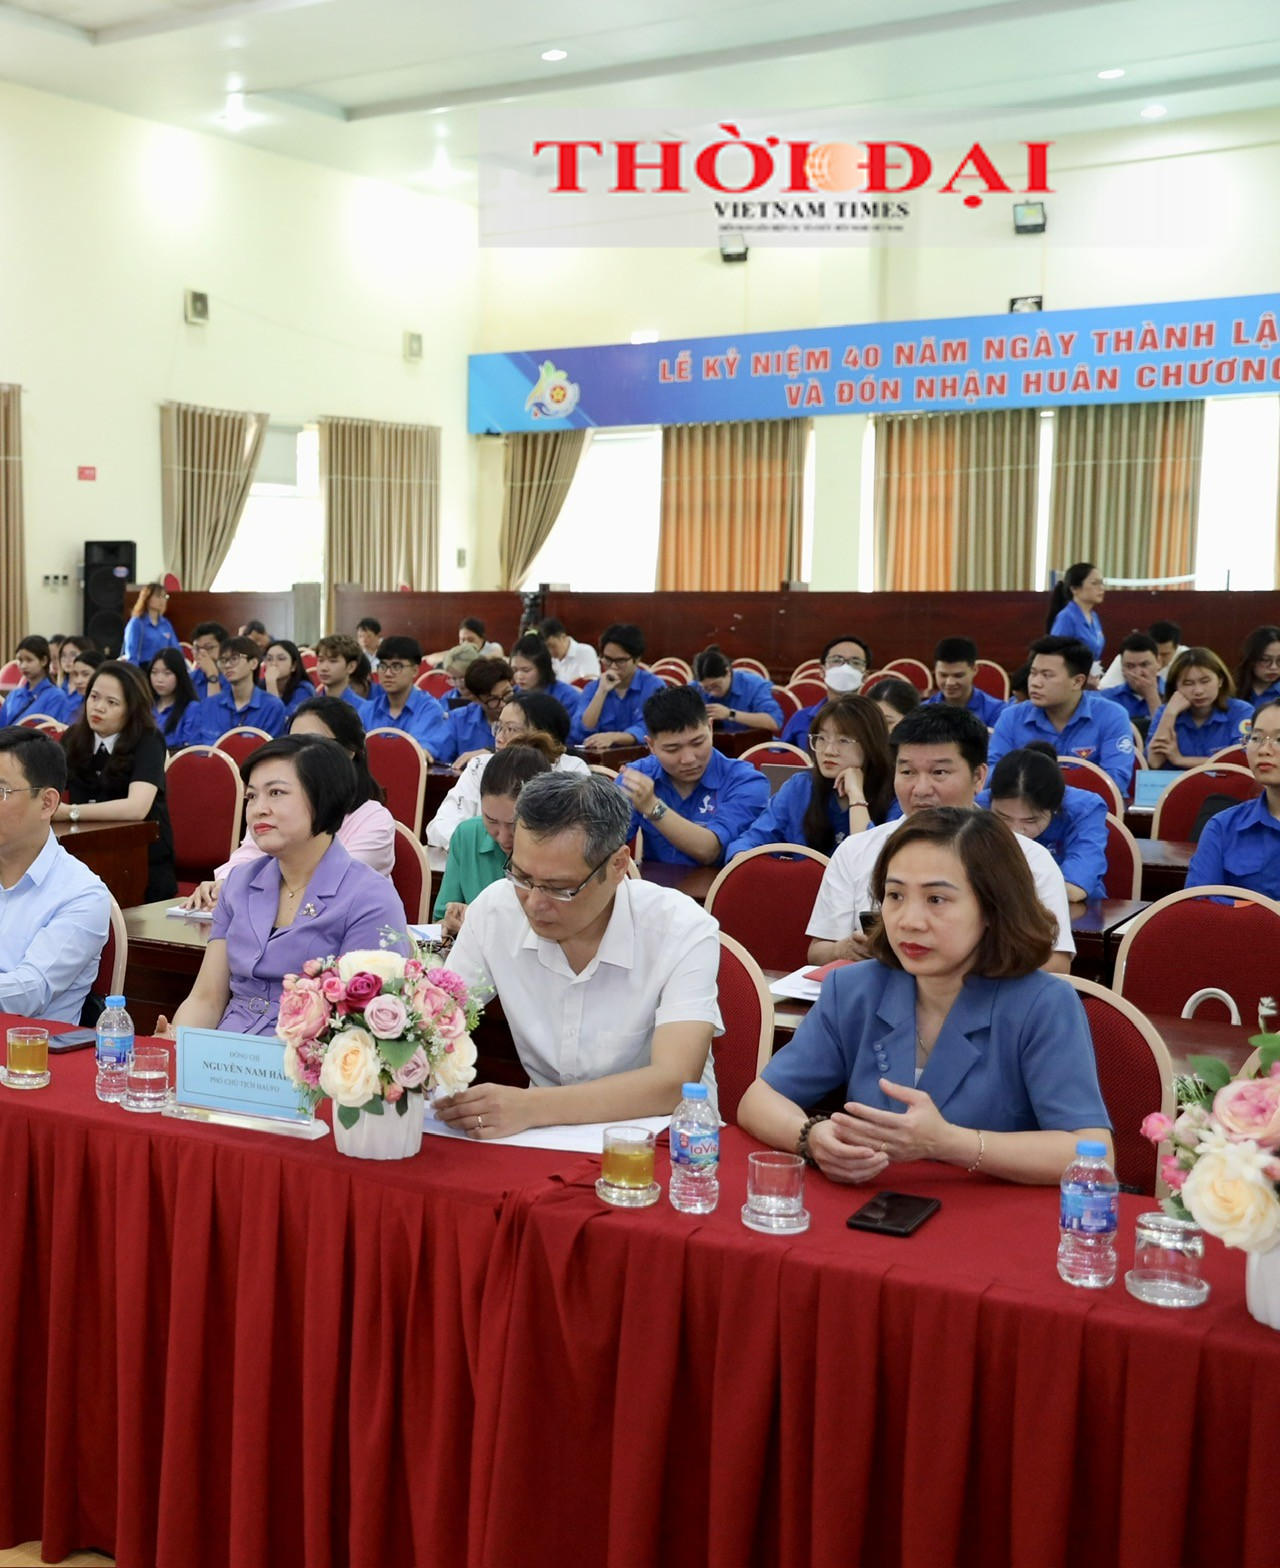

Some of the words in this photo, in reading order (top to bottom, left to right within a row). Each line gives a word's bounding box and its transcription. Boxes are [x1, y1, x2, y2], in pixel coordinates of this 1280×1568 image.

[659, 350, 693, 383] LỄ
[703, 348, 740, 380] KỶ
[751, 345, 830, 379] NIỆM
[842, 346, 881, 370] 40
[894, 335, 969, 368] NĂM
[982, 328, 1077, 361] NGÀY
[1091, 320, 1216, 356] THÀNH
[785, 377, 824, 408] VÀ
[836, 375, 901, 405] ĐÓN
[915, 370, 1007, 404] NHẬN
[1022, 364, 1119, 395] HUÂN
[245, 1066, 267, 1078] NAM
